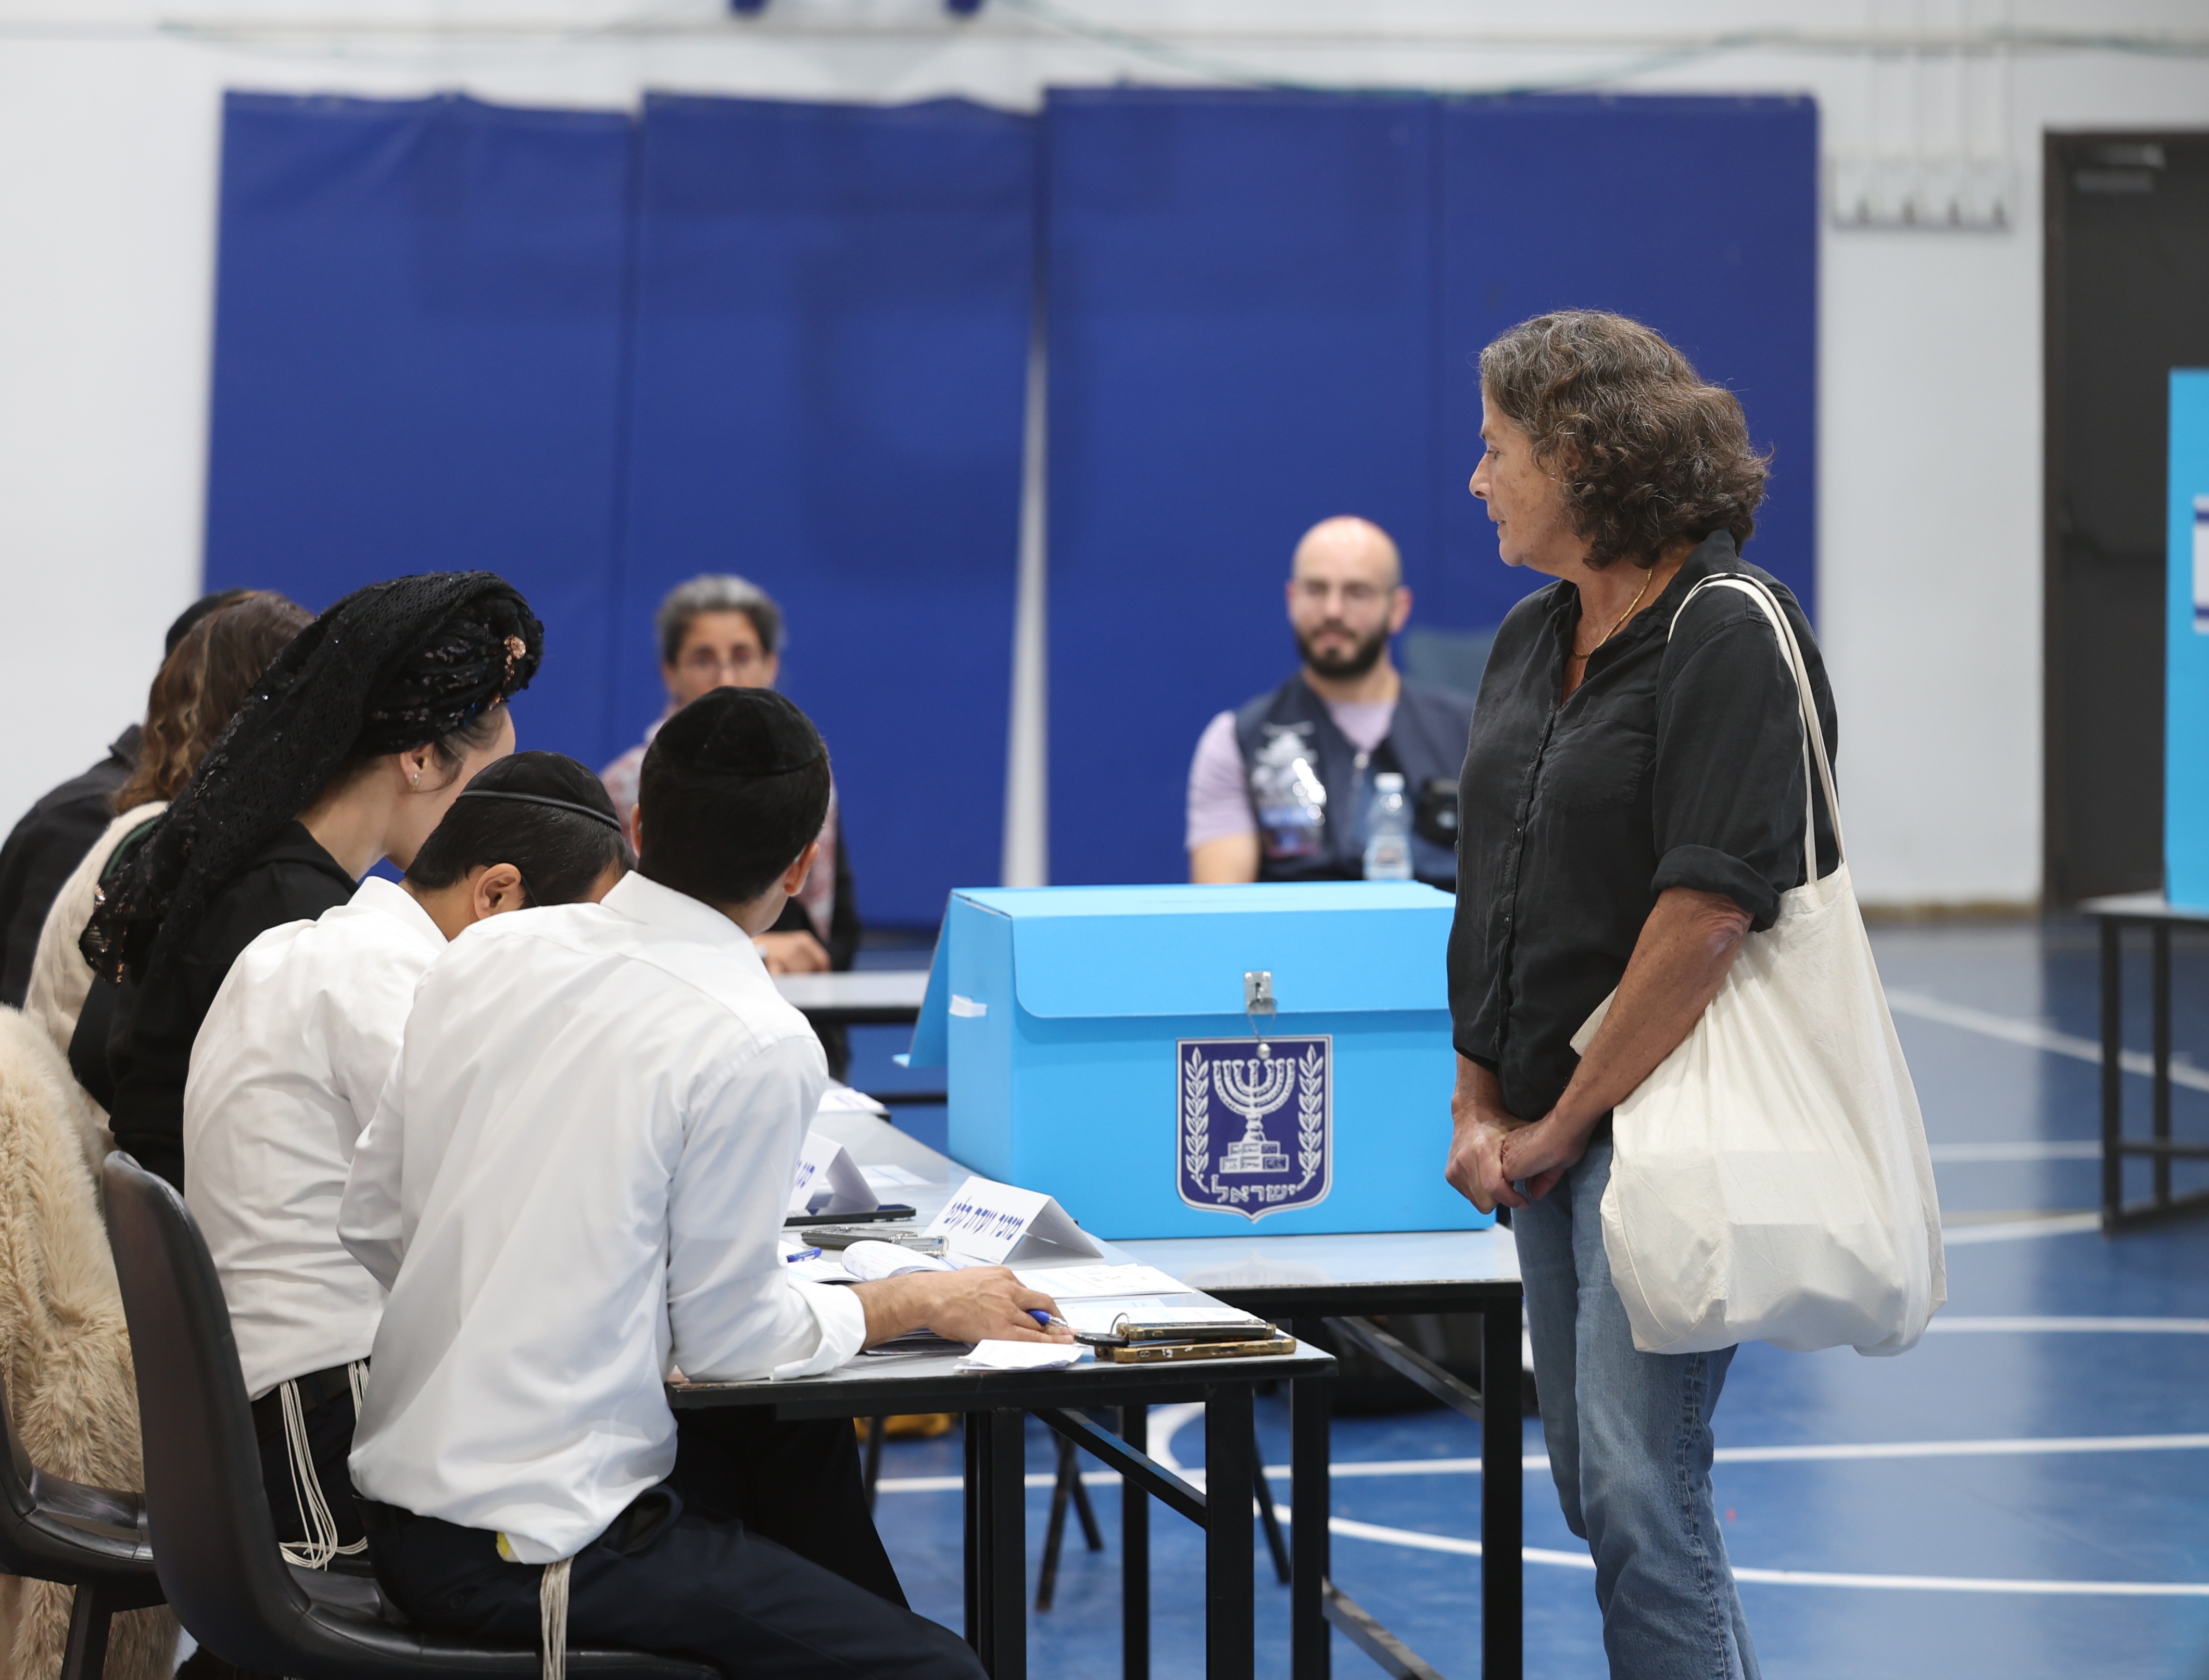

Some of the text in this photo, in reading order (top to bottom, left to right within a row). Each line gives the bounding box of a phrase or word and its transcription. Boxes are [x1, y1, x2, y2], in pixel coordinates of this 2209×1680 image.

[1211, 1174, 1297, 1203] ישראל
[944, 1196, 1024, 1240] מזכיר ועדת קלפי
